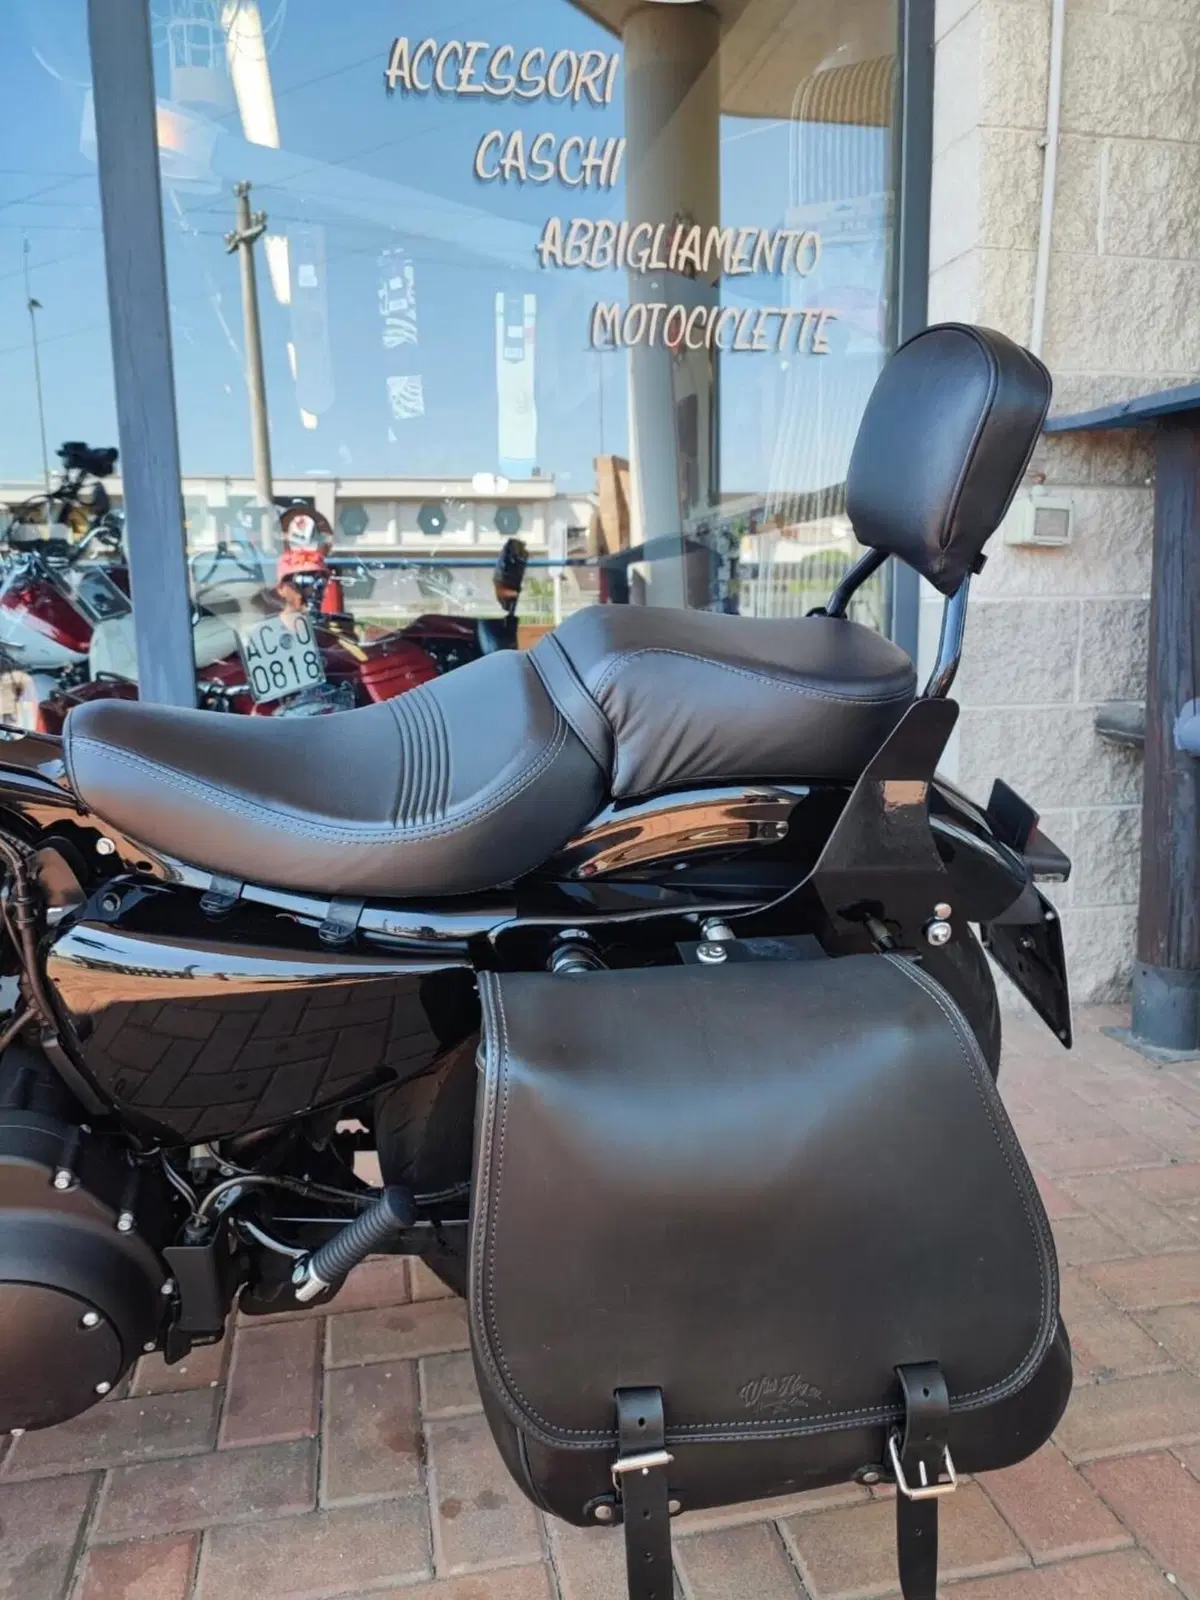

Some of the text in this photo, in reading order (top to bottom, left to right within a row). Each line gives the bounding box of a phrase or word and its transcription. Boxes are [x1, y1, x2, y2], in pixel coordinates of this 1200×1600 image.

[386, 37, 620, 103] ACCESSORI
[474, 130, 625, 187] CASCHI
[537, 216, 822, 276] ABBIGLIAMENTO
[591, 302, 839, 355] MOTOCICLETTE
[252, 651, 320, 694] 0818
